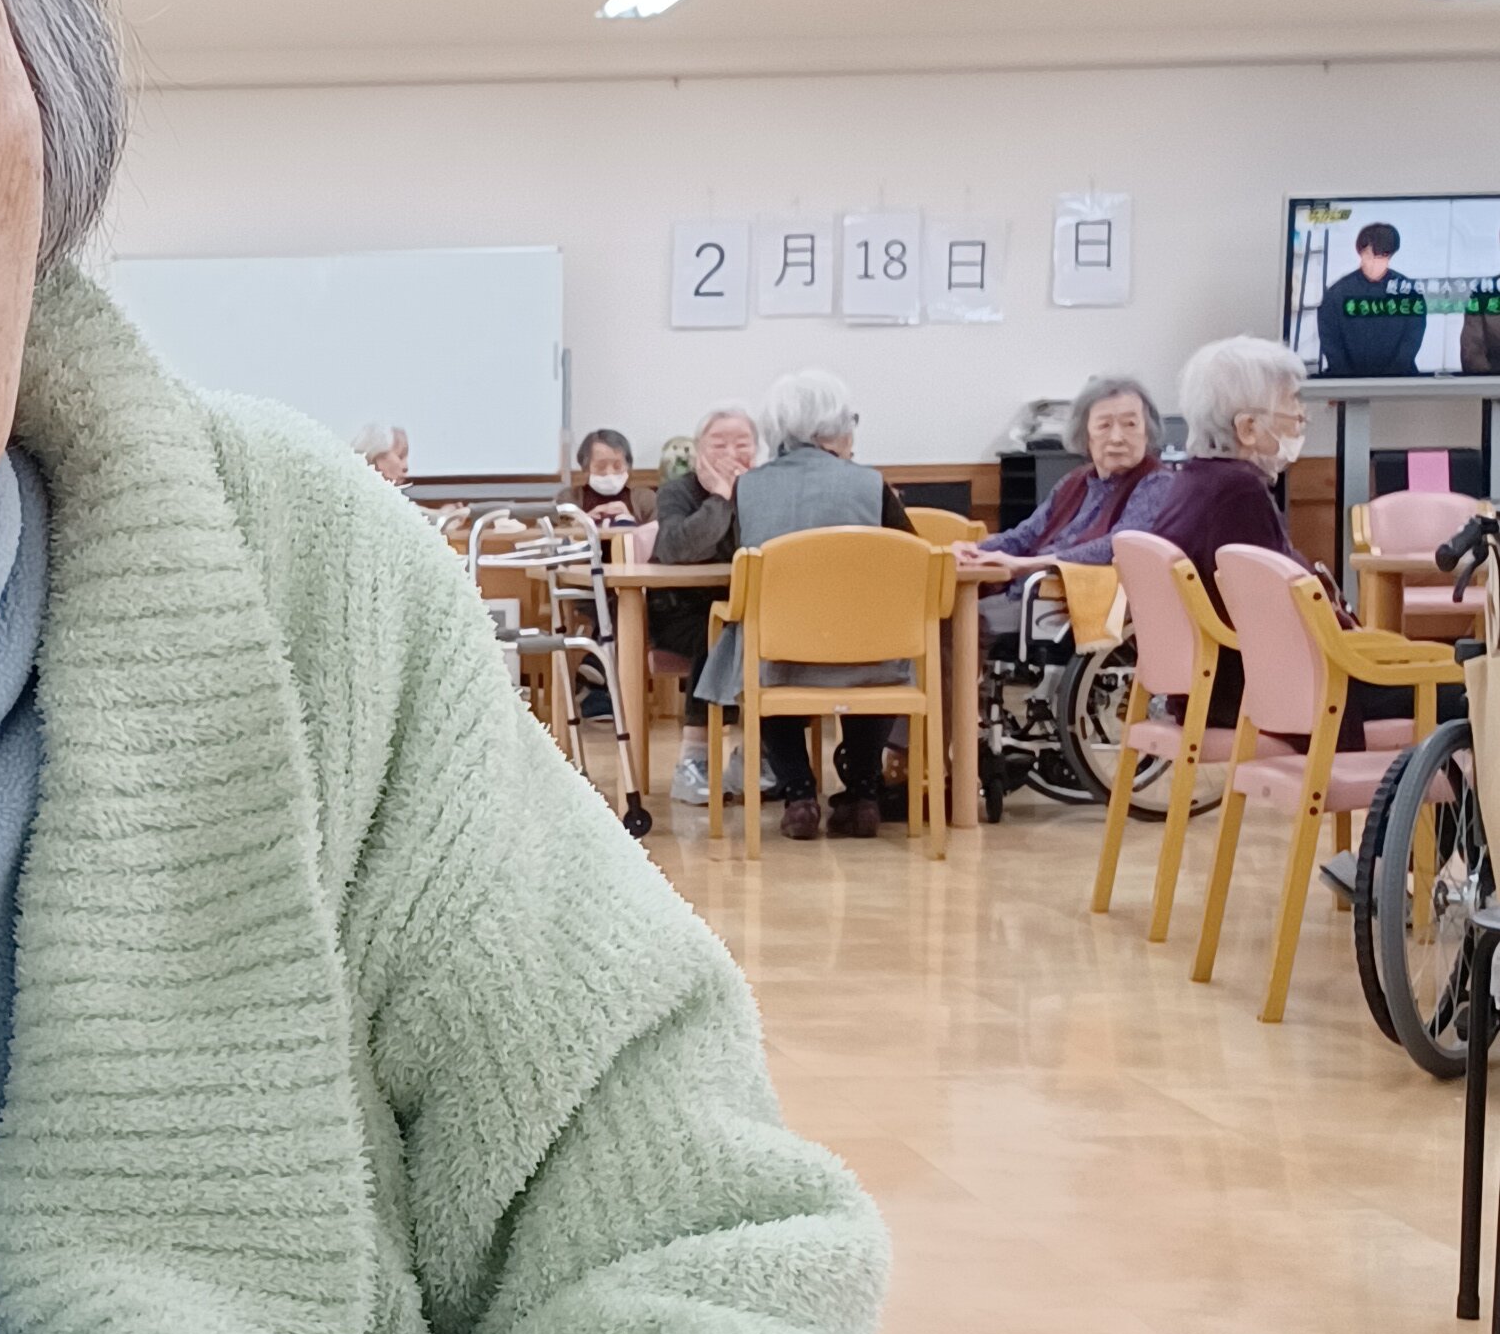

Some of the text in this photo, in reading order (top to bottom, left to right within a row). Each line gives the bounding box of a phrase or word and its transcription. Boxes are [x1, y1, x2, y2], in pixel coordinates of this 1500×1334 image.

[693, 242, 725, 297] 2
[856, 239, 908, 281] 18
[947, 240, 986, 291] 日
[1074, 219, 1112, 270] 日
